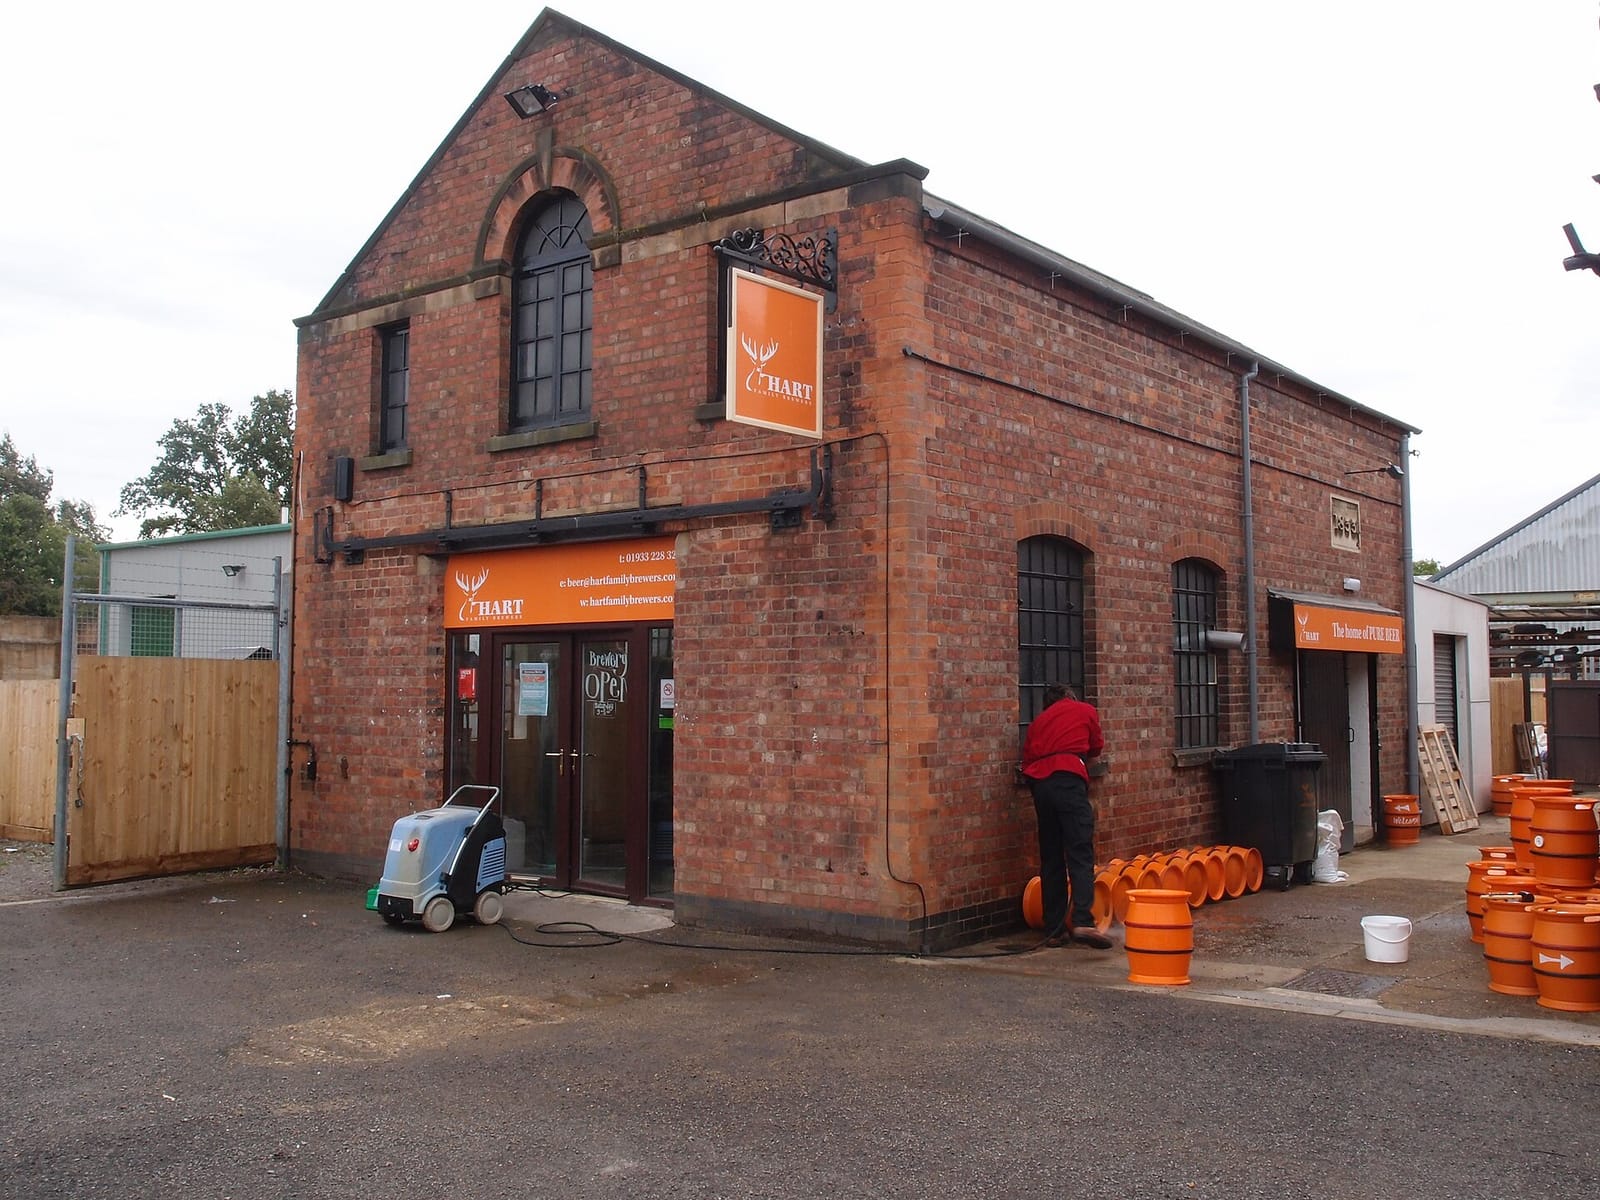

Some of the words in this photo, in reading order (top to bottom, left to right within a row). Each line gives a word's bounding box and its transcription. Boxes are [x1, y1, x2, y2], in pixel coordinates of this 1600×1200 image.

[767, 376, 813, 400] HART
[626, 552, 649, 563] 01933
[650, 551, 665, 561] 228
[666, 550, 676, 560] 32
[559, 579, 566, 588] e:
[479, 599, 524, 616] HART
[580, 599, 589, 607] w:
[590, 594, 675, 607] hartfamilybrewers.co
[1332, 622, 1345, 638] The
[1345, 623, 1361, 640] home
[1362, 625, 1369, 640] of
[1369, 626, 1385, 641] PURE
[1385, 628, 1400, 642] BEER
